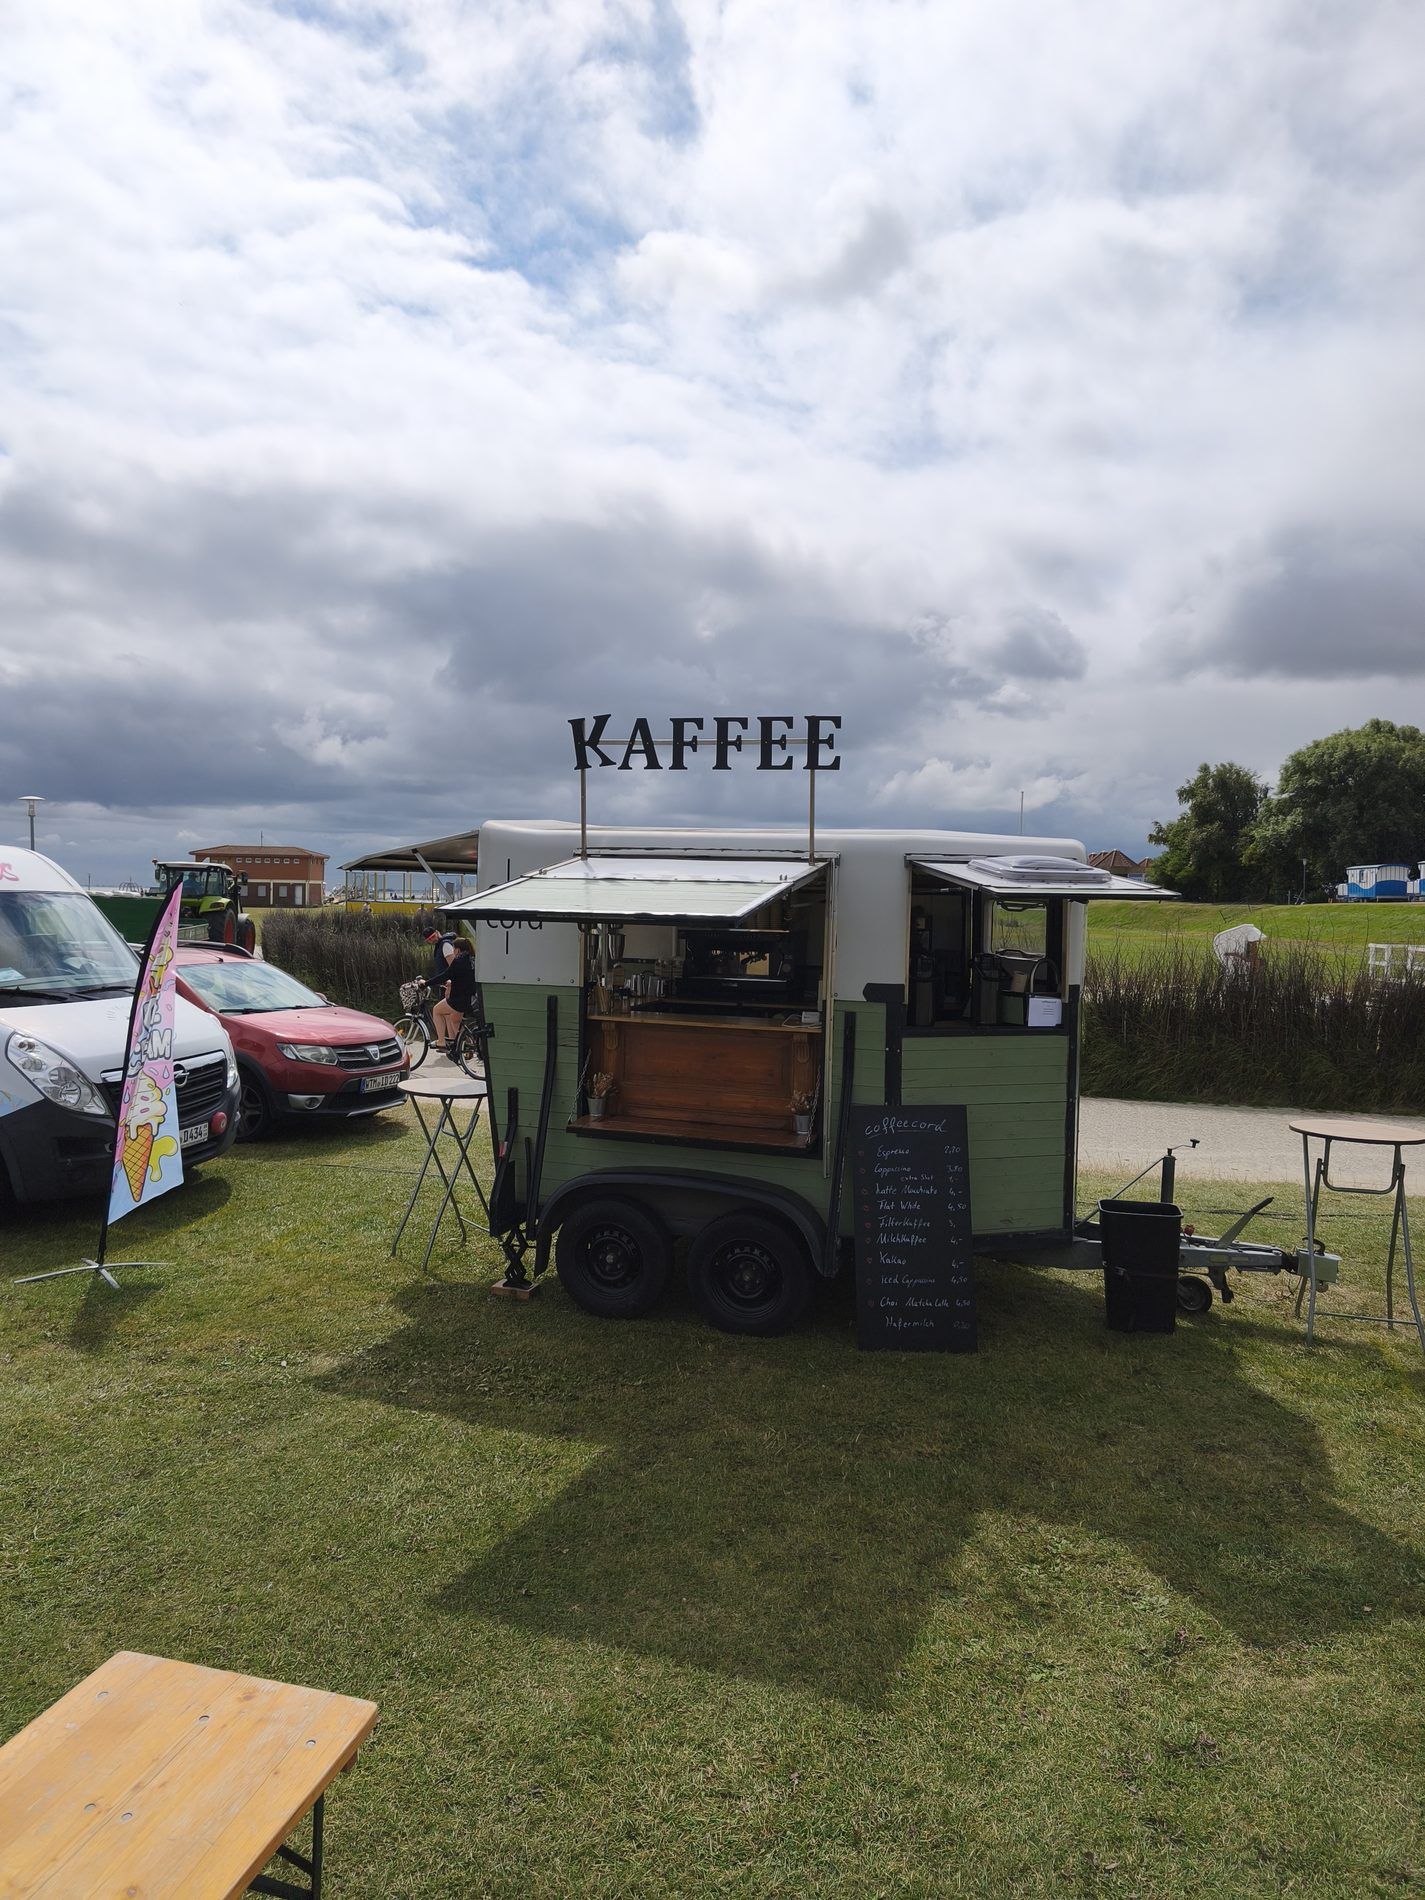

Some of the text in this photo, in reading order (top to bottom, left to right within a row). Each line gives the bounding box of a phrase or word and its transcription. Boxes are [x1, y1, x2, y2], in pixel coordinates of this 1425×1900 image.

[568, 714, 842, 770] KAFFEE
[877, 1145, 910, 1160] Espresso
[874, 1163, 911, 1178] Cappuccino
[875, 1182, 897, 1195] Latte
[877, 1199, 895, 1211] Flat
[900, 1200, 921, 1211] White
[879, 1251, 907, 1265] Kakao
[885, 1316, 935, 1331] Hafermilch
